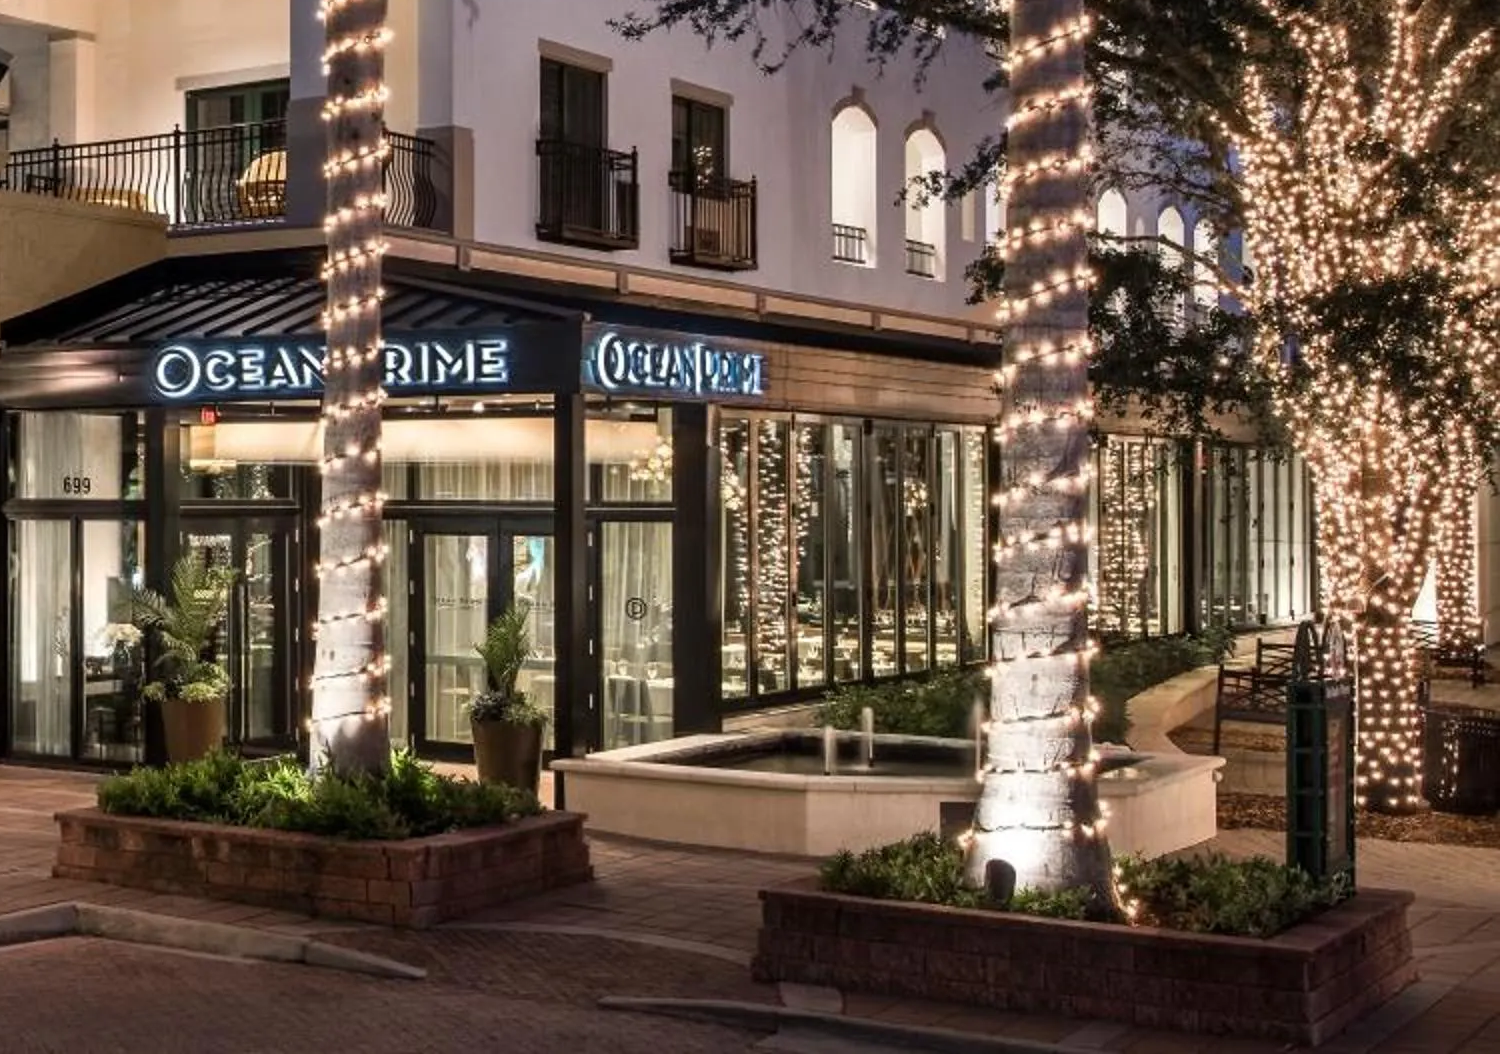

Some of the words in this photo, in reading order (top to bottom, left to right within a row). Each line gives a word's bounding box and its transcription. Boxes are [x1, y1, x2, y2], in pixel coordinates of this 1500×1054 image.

[156, 346, 327, 397] OCEAN
[381, 340, 508, 384] RIME
[63, 476, 91, 494] 699
